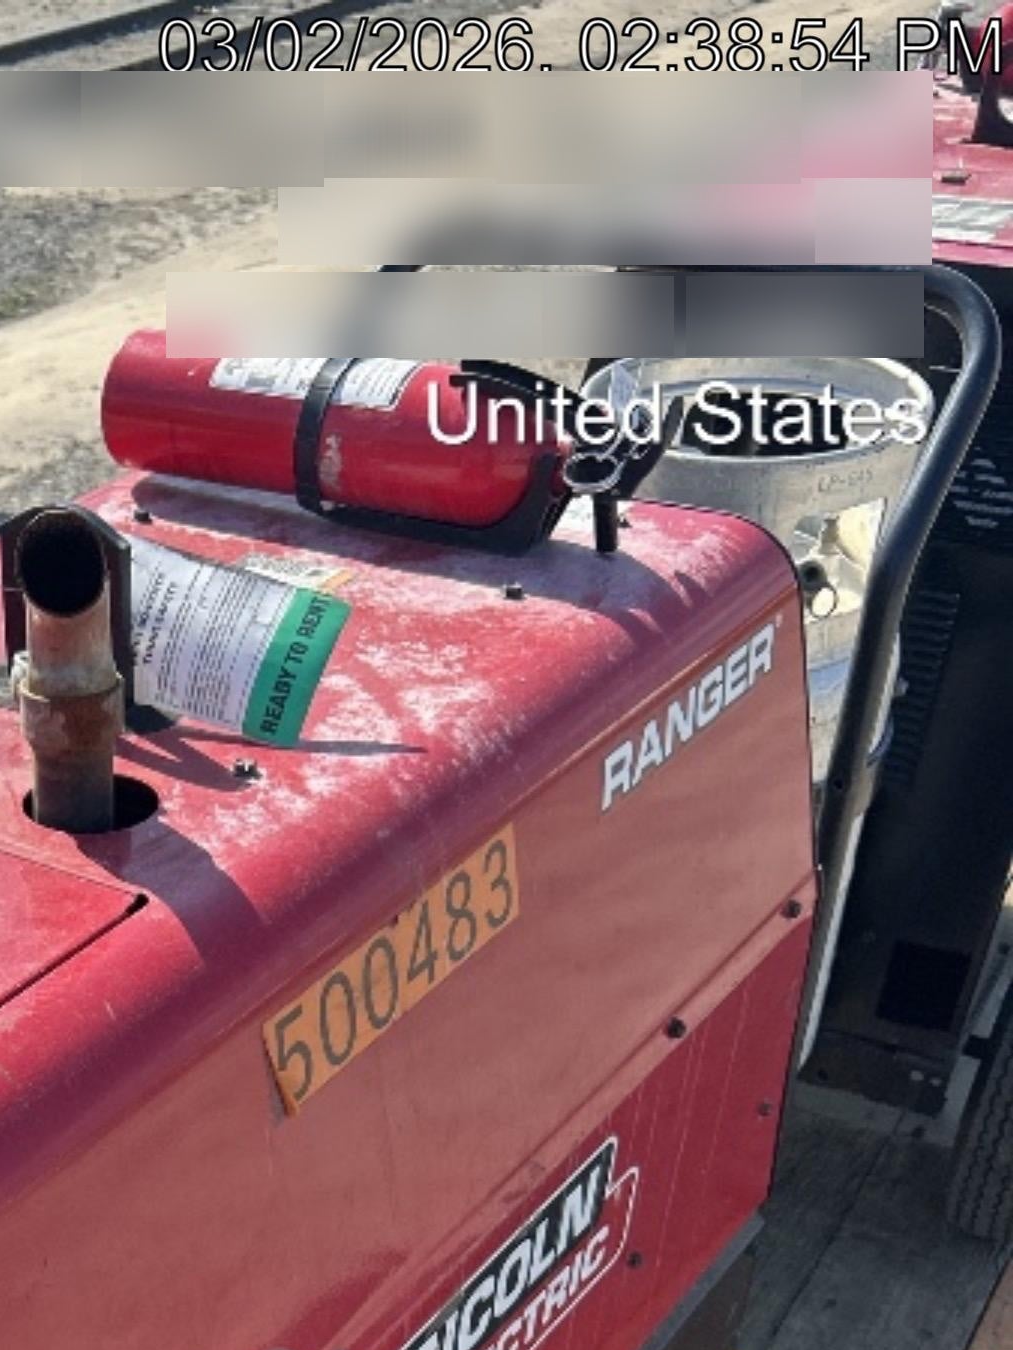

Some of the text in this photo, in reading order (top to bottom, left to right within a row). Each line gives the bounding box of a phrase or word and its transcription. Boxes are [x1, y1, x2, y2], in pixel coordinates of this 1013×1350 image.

[259, 667, 299, 736] READY
[285, 640, 309, 665] TO
[601, 622, 776, 812] RANGER
[273, 838, 516, 1102] 500483
